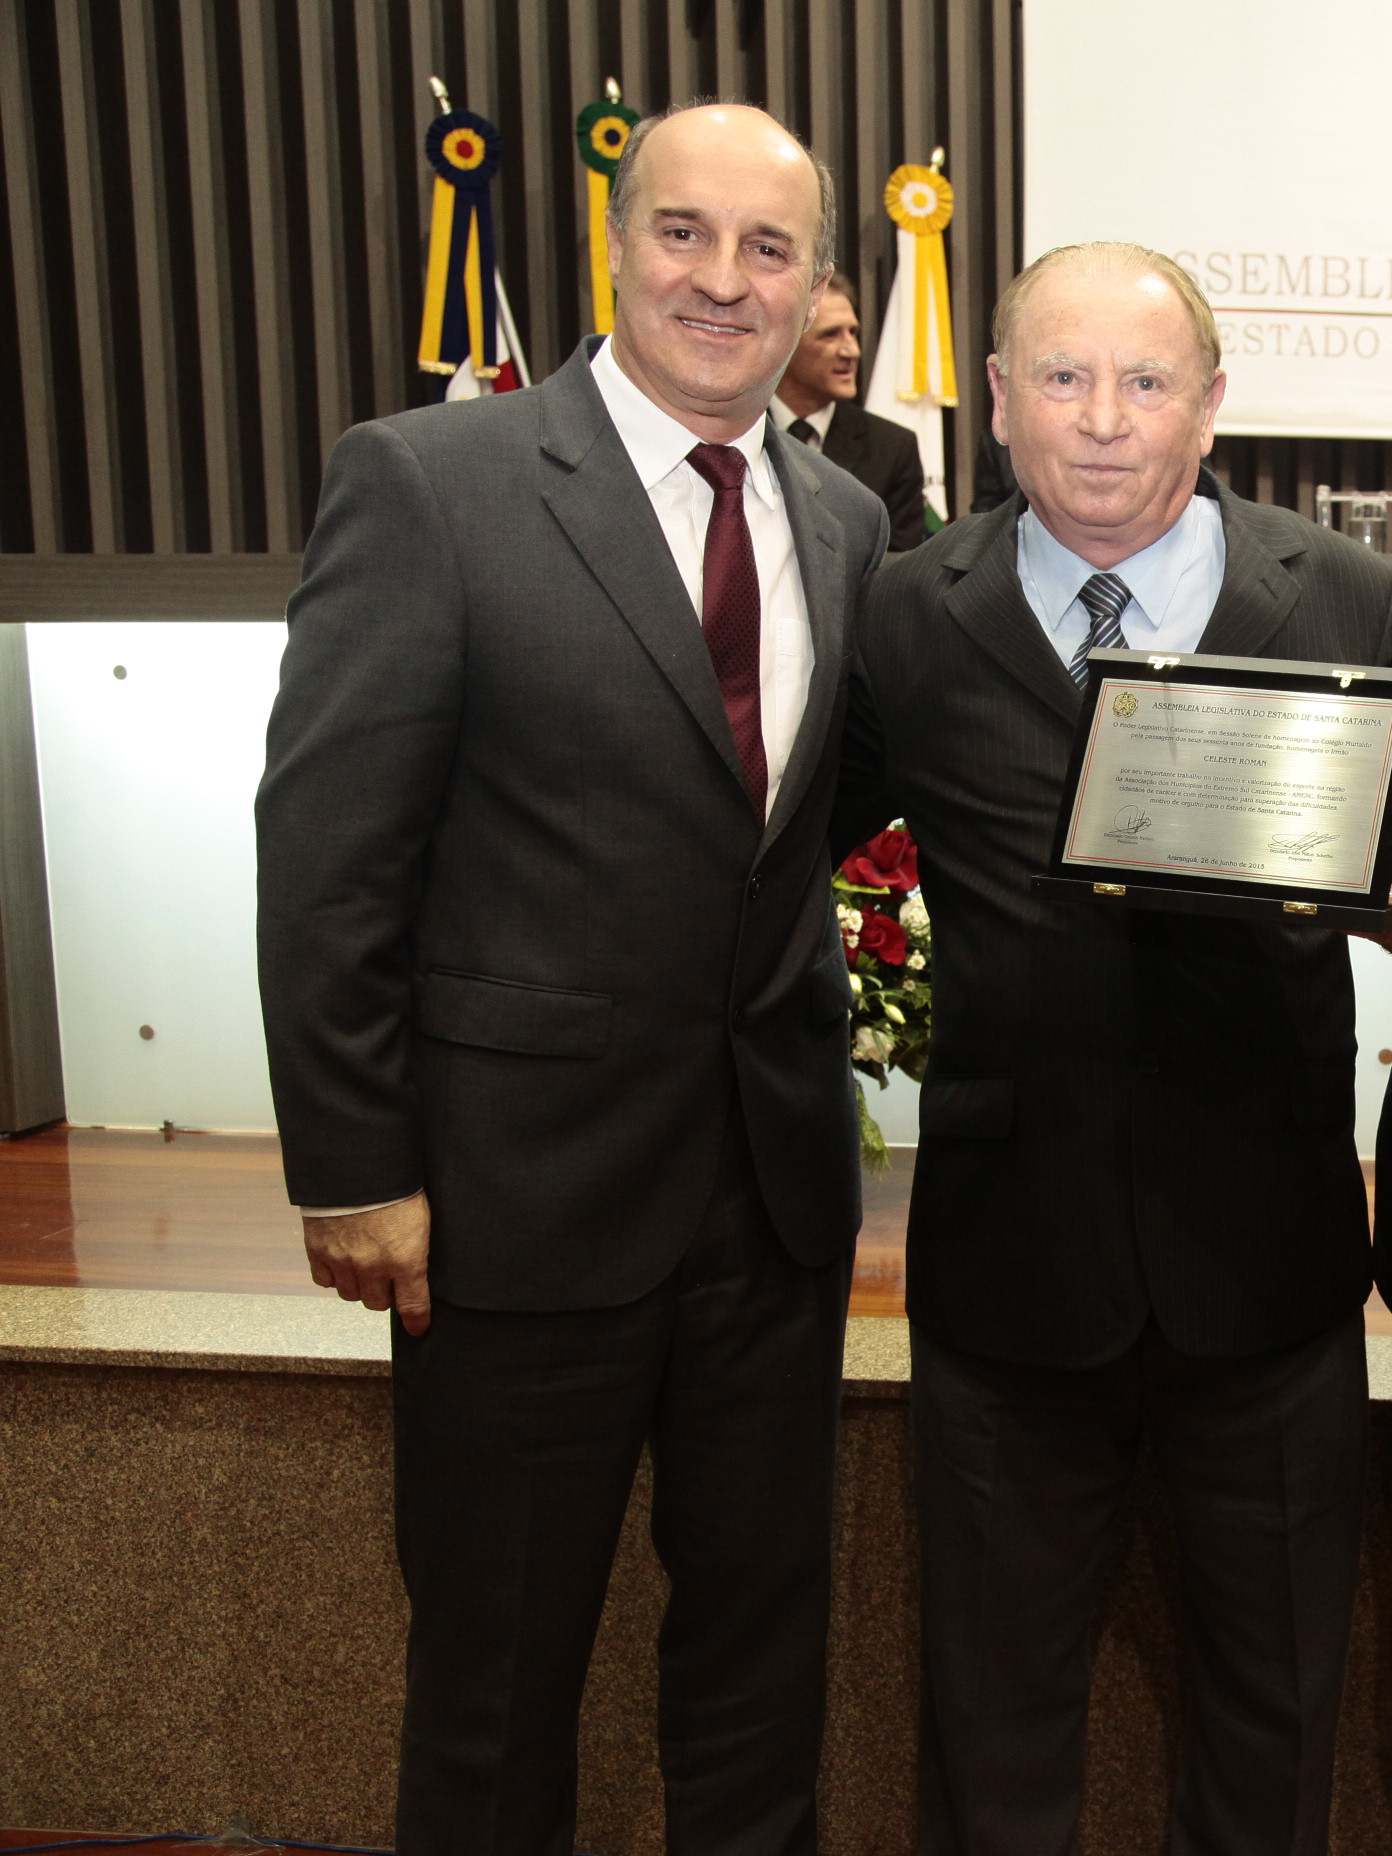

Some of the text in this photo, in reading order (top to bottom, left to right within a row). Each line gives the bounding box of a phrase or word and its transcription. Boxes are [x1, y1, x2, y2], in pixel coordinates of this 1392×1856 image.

[1218, 322, 1381, 360] ESTADO
[1152, 702, 1199, 712] ASSEMBLEIA
[1201, 706, 1250, 716] LEGISLATIVA
[1267, 710, 1298, 720] ESTADO
[1314, 714, 1340, 724] SANTA
[1342, 717, 1382, 726] CATARINA
[1272, 735, 1310, 744] homenagem
[1321, 738, 1343, 746] Colégio
[1204, 755, 1267, 766] CELESTE ROMAN
[1144, 770, 1176, 778] importante
[1124, 777, 1156, 785] Associação
[1213, 784, 1238, 792] Extremo
[1251, 788, 1286, 796] Catarinense
[1316, 794, 1347, 802] formando
[1198, 792, 1238, 801] determinação
